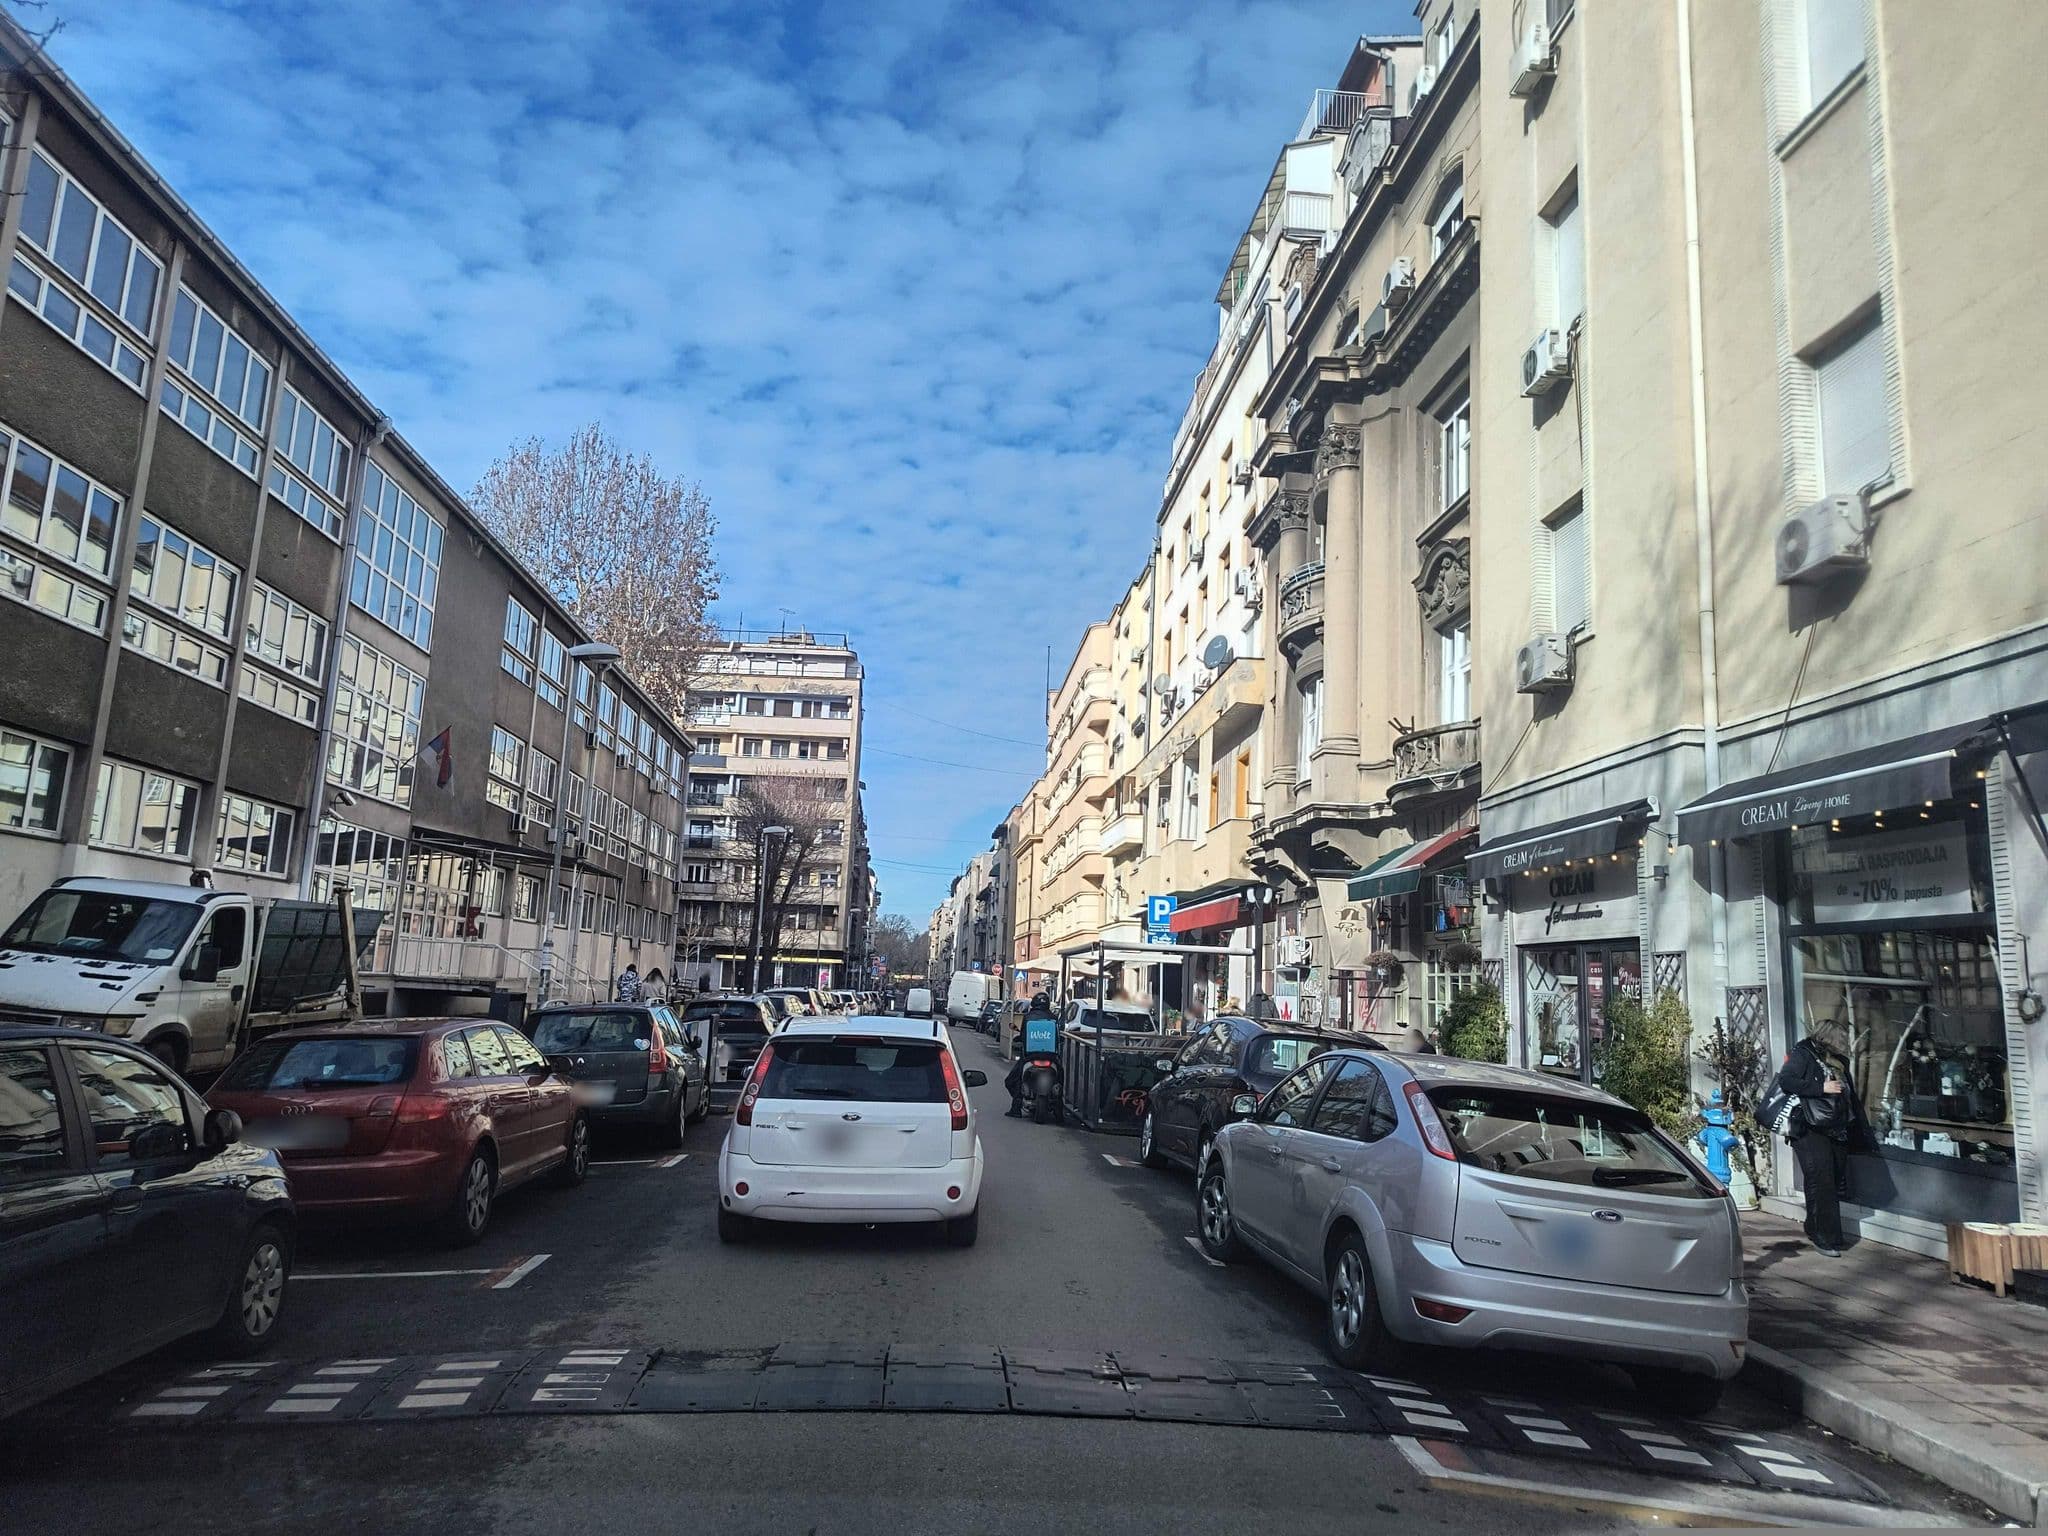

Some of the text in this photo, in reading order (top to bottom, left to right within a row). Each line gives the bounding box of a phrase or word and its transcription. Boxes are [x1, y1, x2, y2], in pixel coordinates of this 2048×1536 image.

[1741, 794, 1851, 826] CREAM Living HOME
[1503, 851, 1528, 869] CREAM
[1867, 844, 1949, 873] RASPRODAJA
[1549, 871, 1594, 898] CREAM
[1904, 884, 1943, 902] popusta
[1154, 899, 1171, 921] P
[1621, 984, 1640, 999] SALE
[1030, 1030, 1052, 1040] Wolt
[1464, 1235, 1502, 1246] FOCUS
